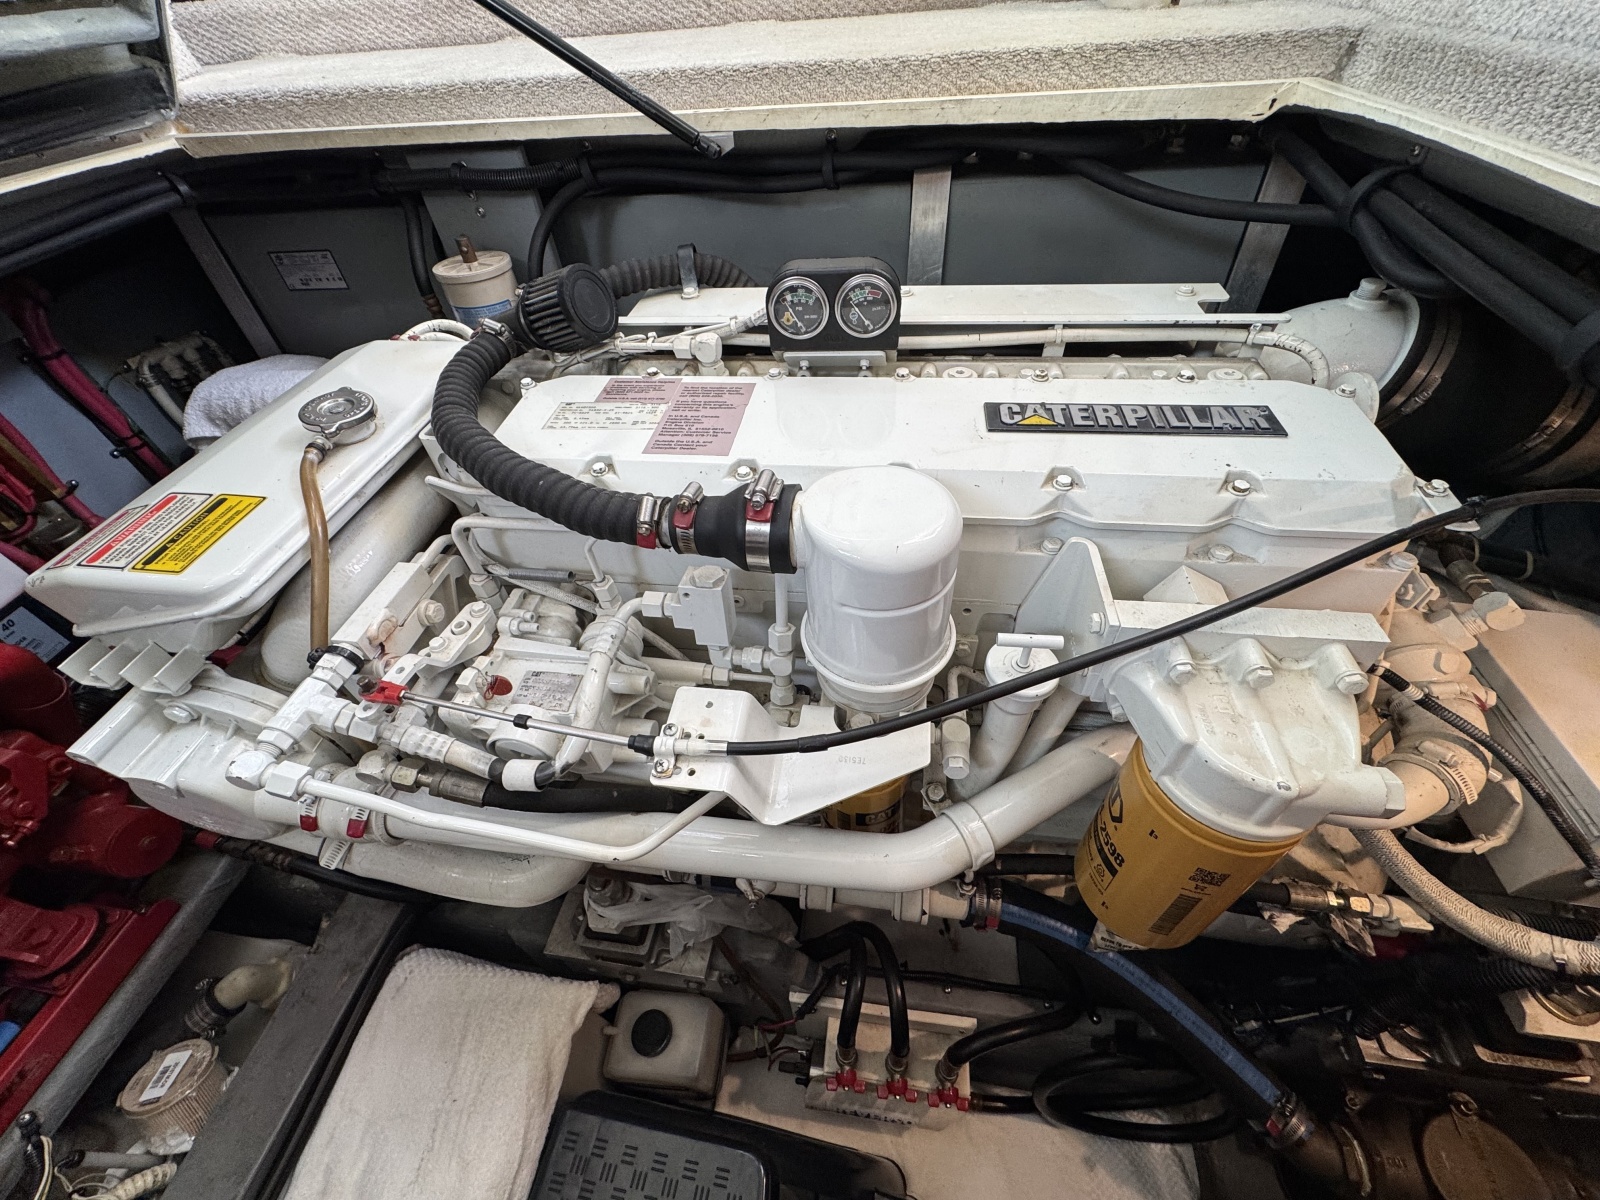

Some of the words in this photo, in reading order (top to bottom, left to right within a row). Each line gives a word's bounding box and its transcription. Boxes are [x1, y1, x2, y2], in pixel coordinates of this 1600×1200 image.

[1000, 403, 1272, 430] CATERPILLAR
[171, 512, 210, 539] CAUTION
[1, 618, 16, 632] 40
[865, 807, 894, 824] CAT
